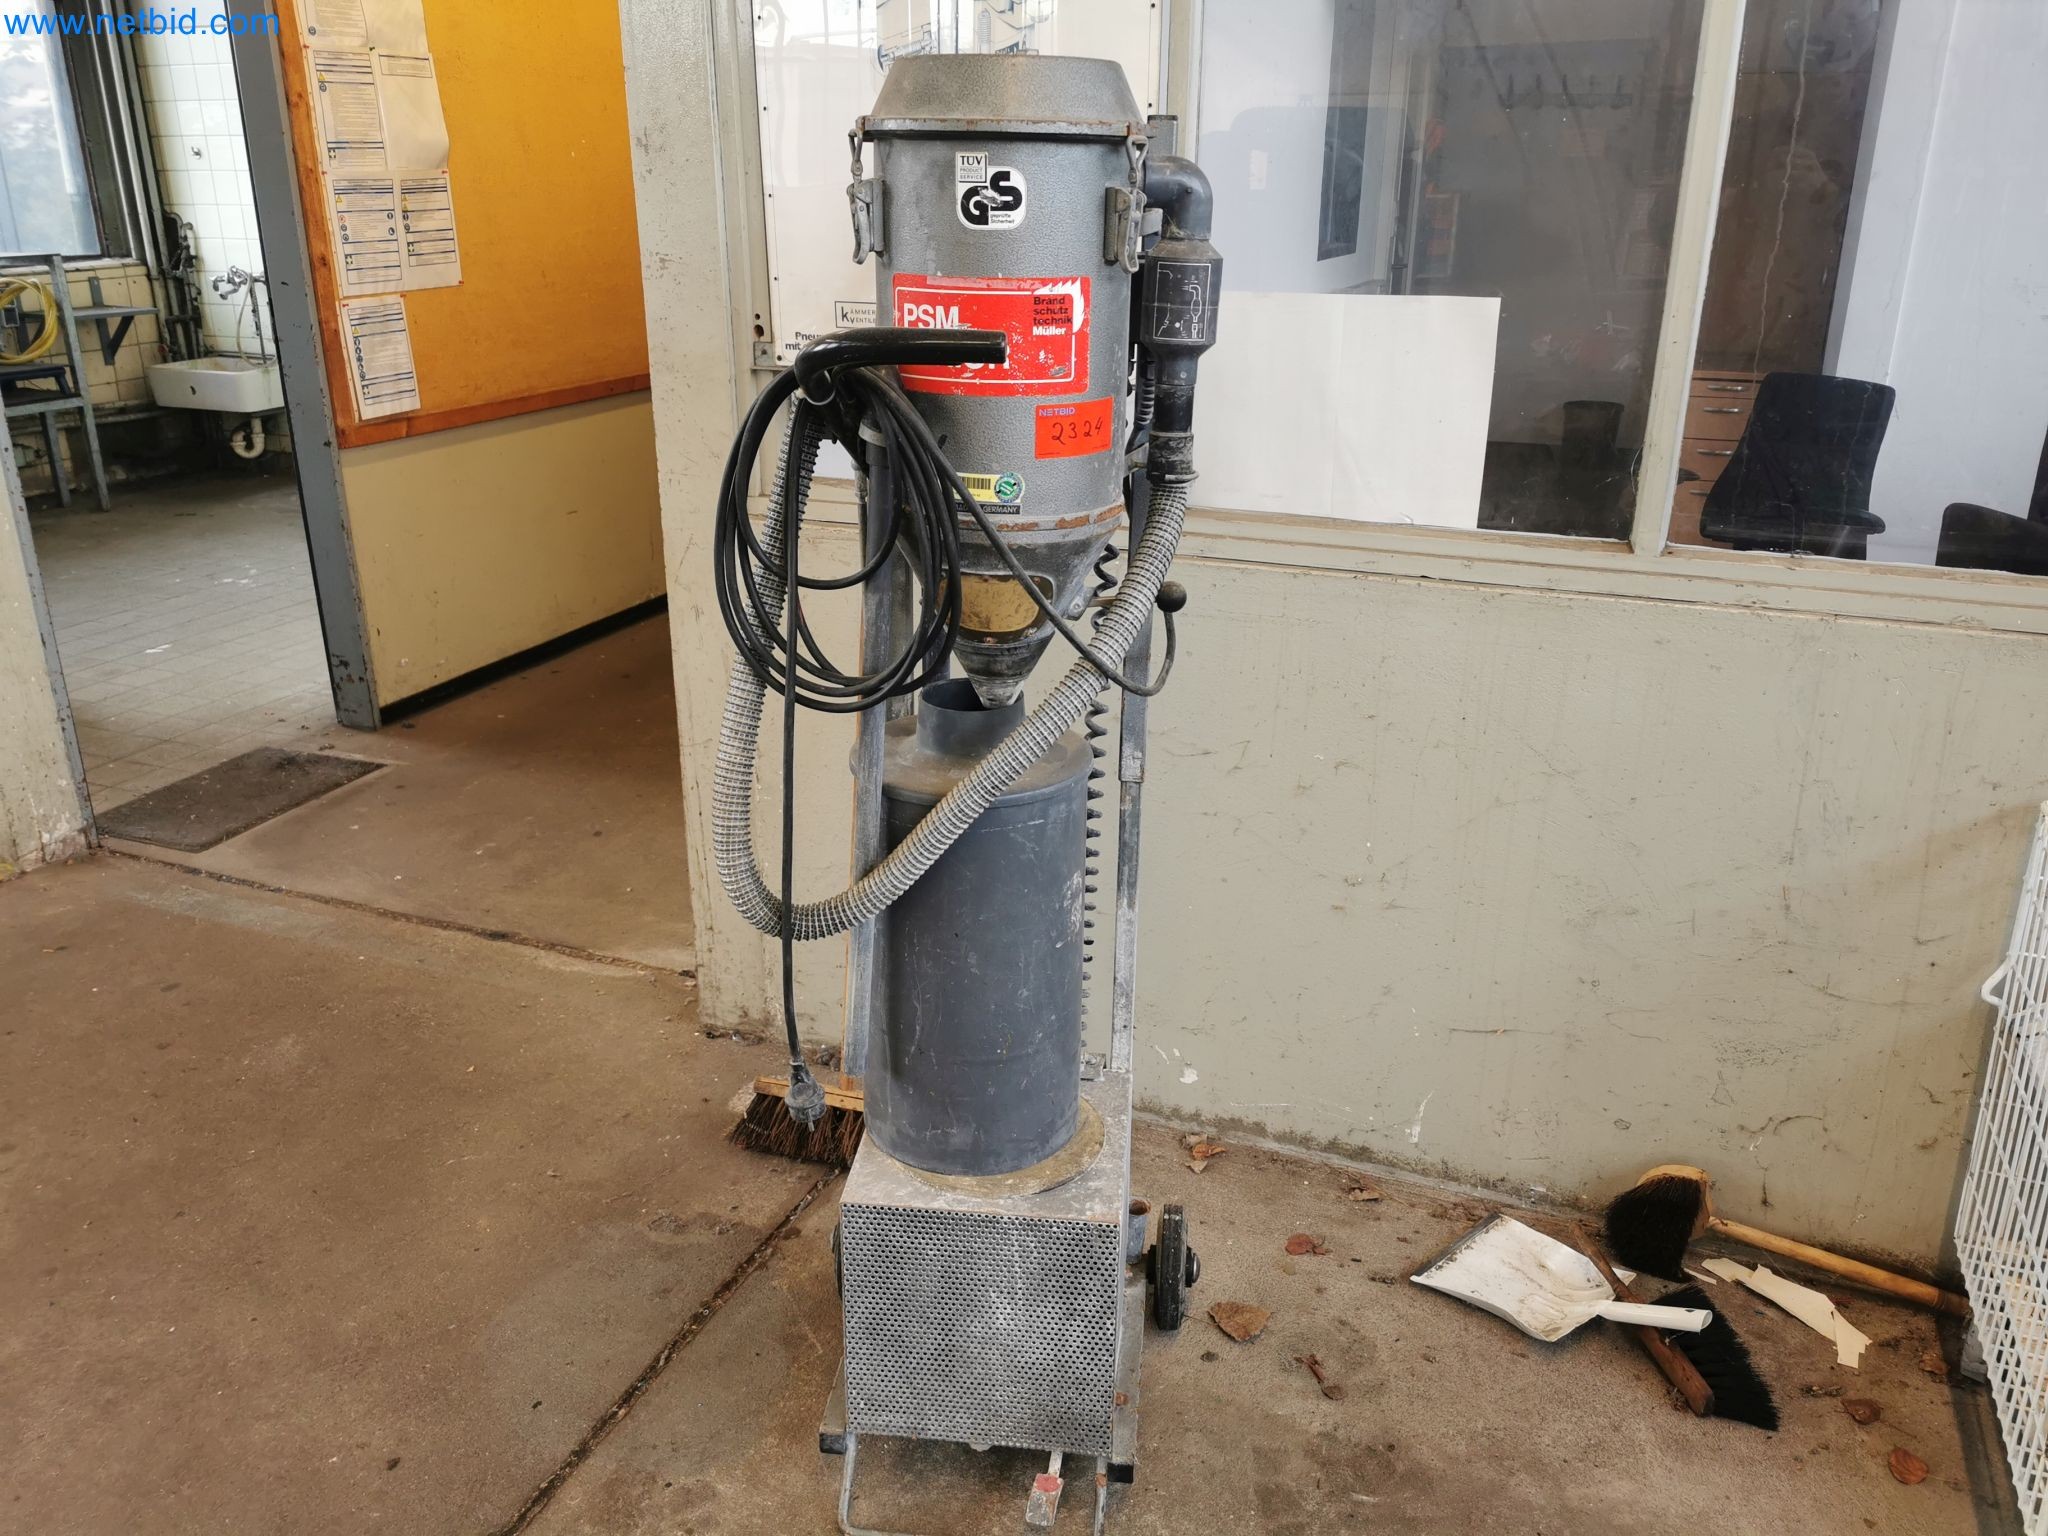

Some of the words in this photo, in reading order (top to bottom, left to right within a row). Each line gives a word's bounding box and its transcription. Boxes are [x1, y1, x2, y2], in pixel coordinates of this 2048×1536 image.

[1033, 296, 1066, 306] Brand
[903, 303, 959, 328] PSM
[1033, 306, 1069, 316] schutz
[1032, 316, 1073, 326] technik
[1032, 325, 1066, 336] Müller
[1038, 407, 1076, 417] NETBID
[1051, 416, 1104, 446] 2324
[982, 504, 1018, 513] GERMANY
